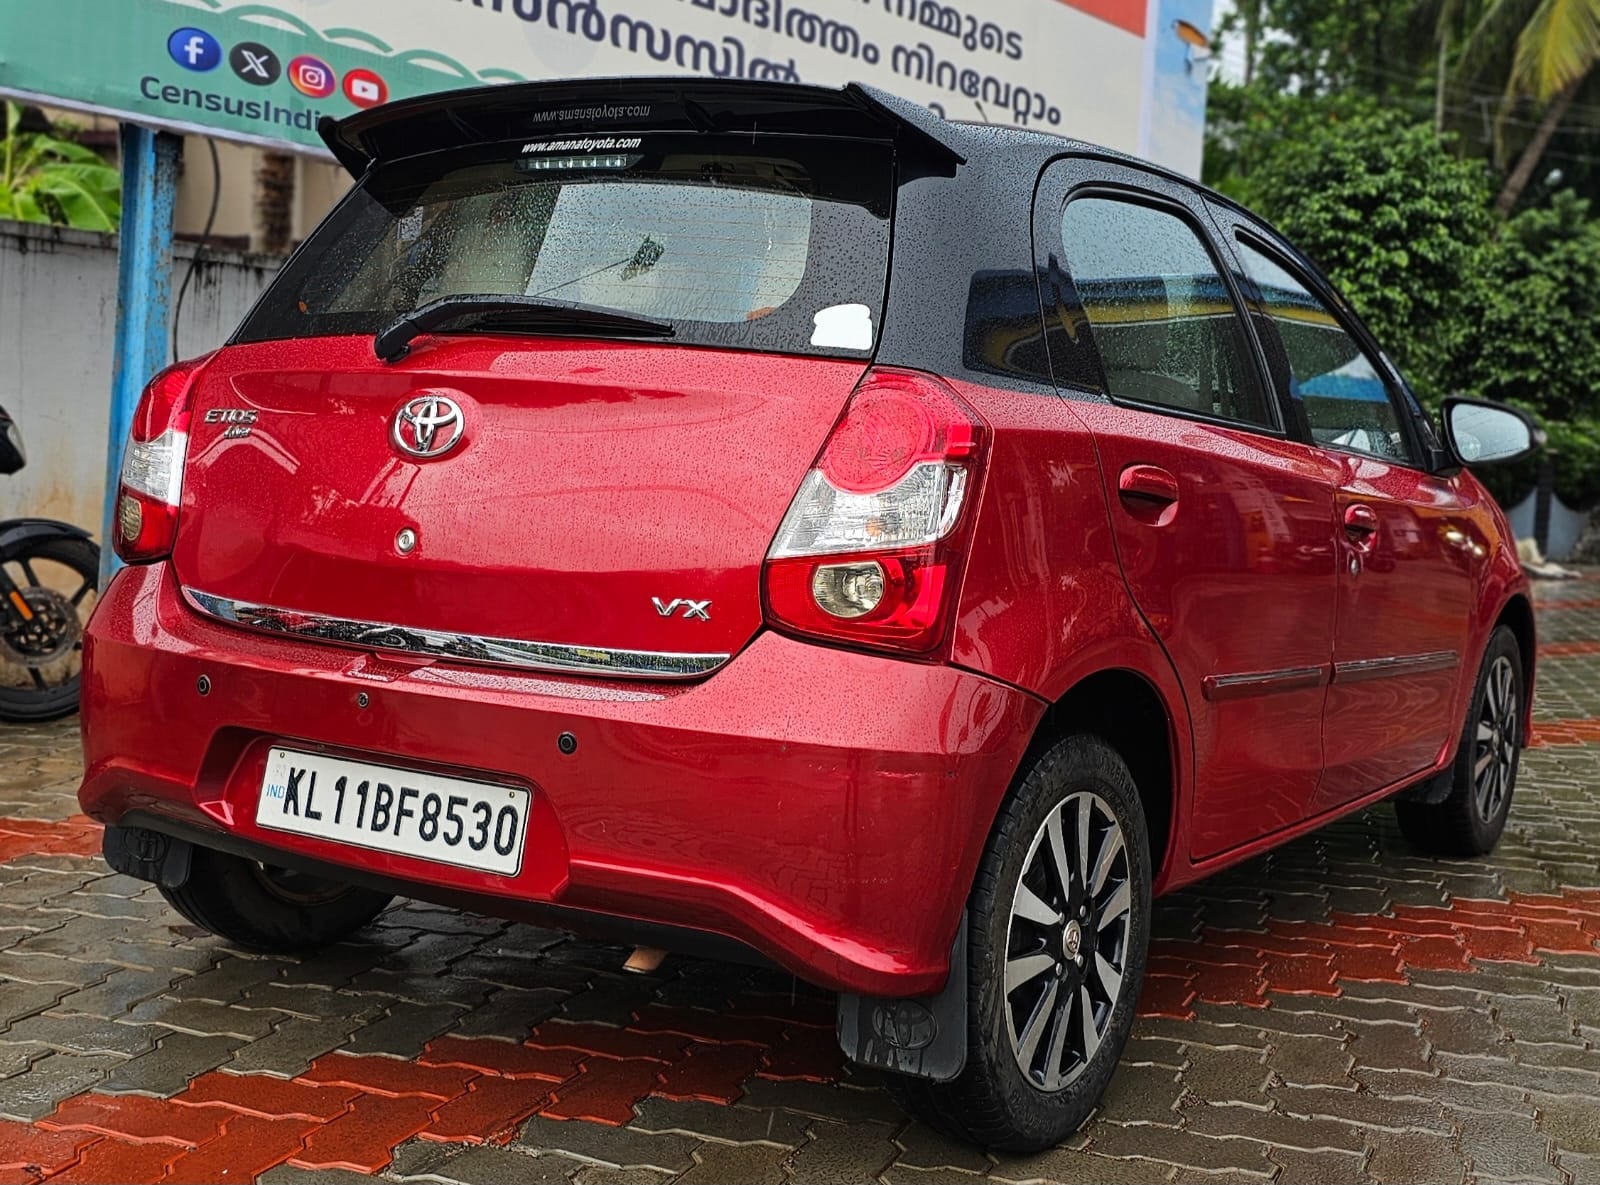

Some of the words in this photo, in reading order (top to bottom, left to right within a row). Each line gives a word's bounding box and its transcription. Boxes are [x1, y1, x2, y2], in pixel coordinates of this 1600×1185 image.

[892, 43, 1062, 126] നിറവേറ്റാം
[140, 76, 320, 132] CensusIndi
[522, 137, 642, 153] www.amanatoyota.com
[205, 408, 258, 424] ETIOS
[651, 596, 712, 621] VX
[266, 783, 285, 799] IND
[283, 767, 518, 856] KL11BF8530
